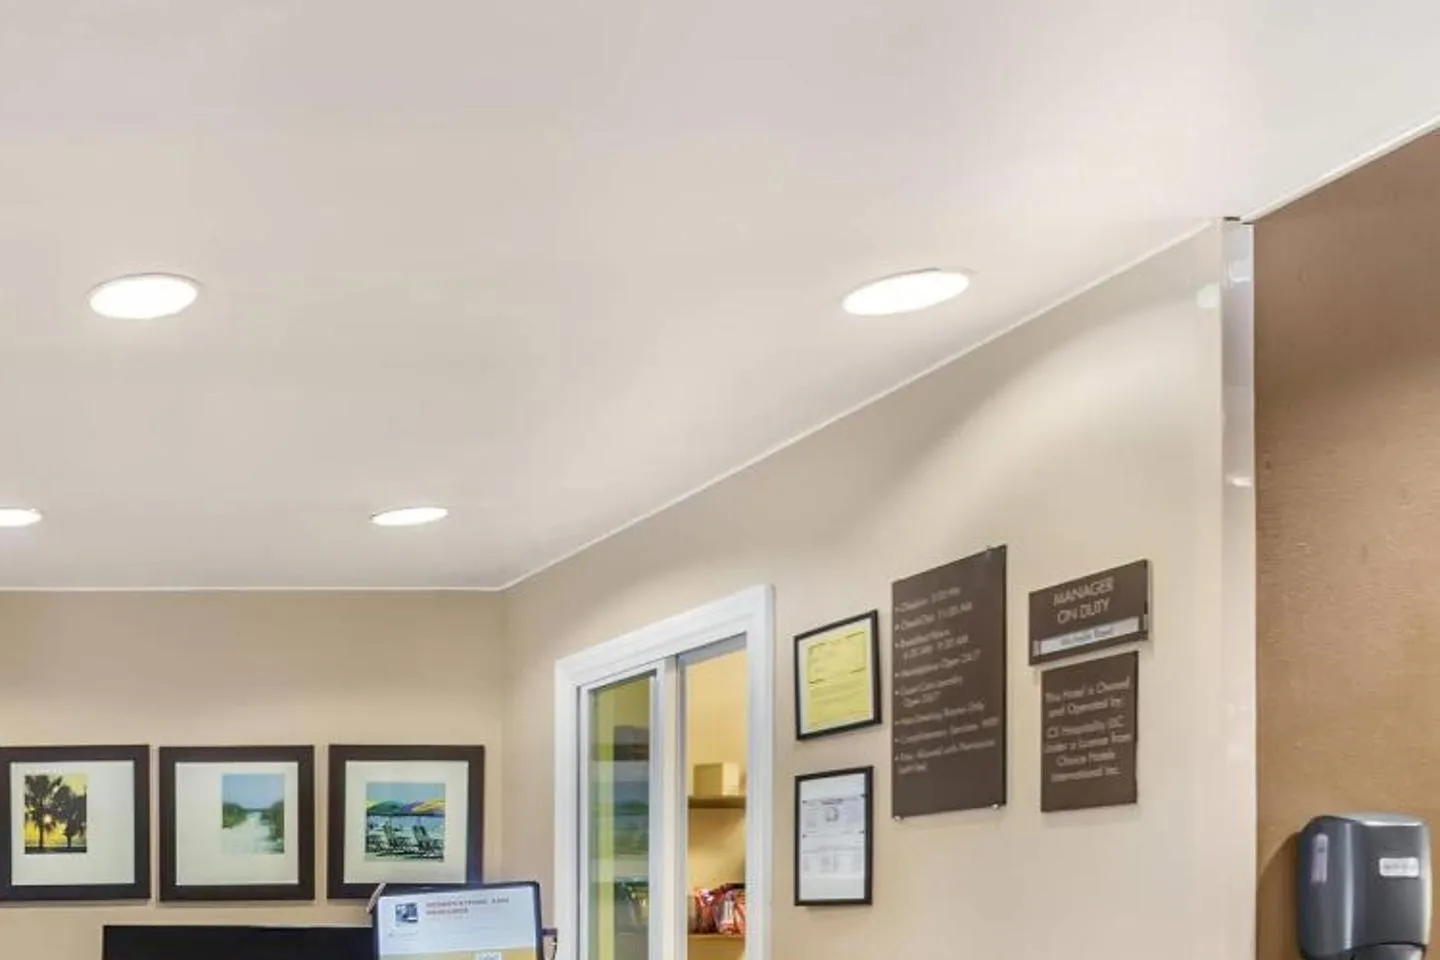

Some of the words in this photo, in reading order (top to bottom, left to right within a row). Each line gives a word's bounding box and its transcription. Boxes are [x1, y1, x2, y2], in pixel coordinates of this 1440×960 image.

[1053, 576, 1115, 607] MANAGER
[1057, 608, 1079, 625] ON
[1080, 597, 1111, 620] DUTY
